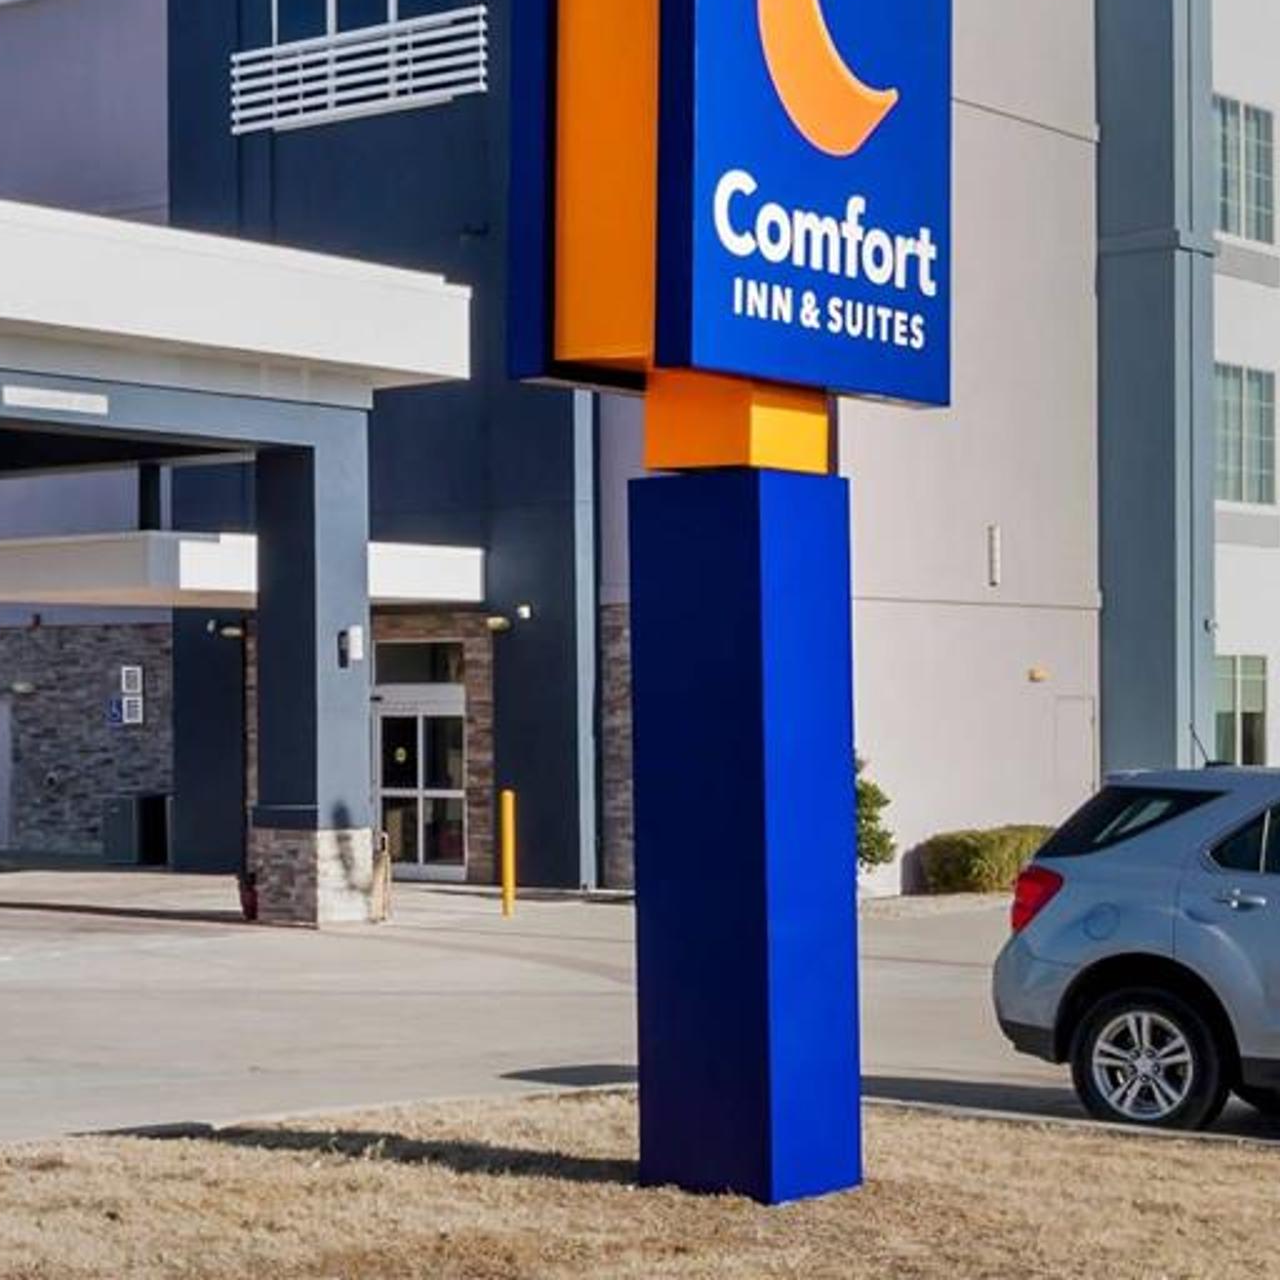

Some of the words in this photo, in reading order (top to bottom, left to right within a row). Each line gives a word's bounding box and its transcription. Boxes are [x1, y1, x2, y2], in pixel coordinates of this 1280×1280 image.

[714, 168, 937, 297] Comfort
[734, 276, 793, 324] INN
[800, 290, 821, 330] &
[827, 296, 924, 350] SUITES
